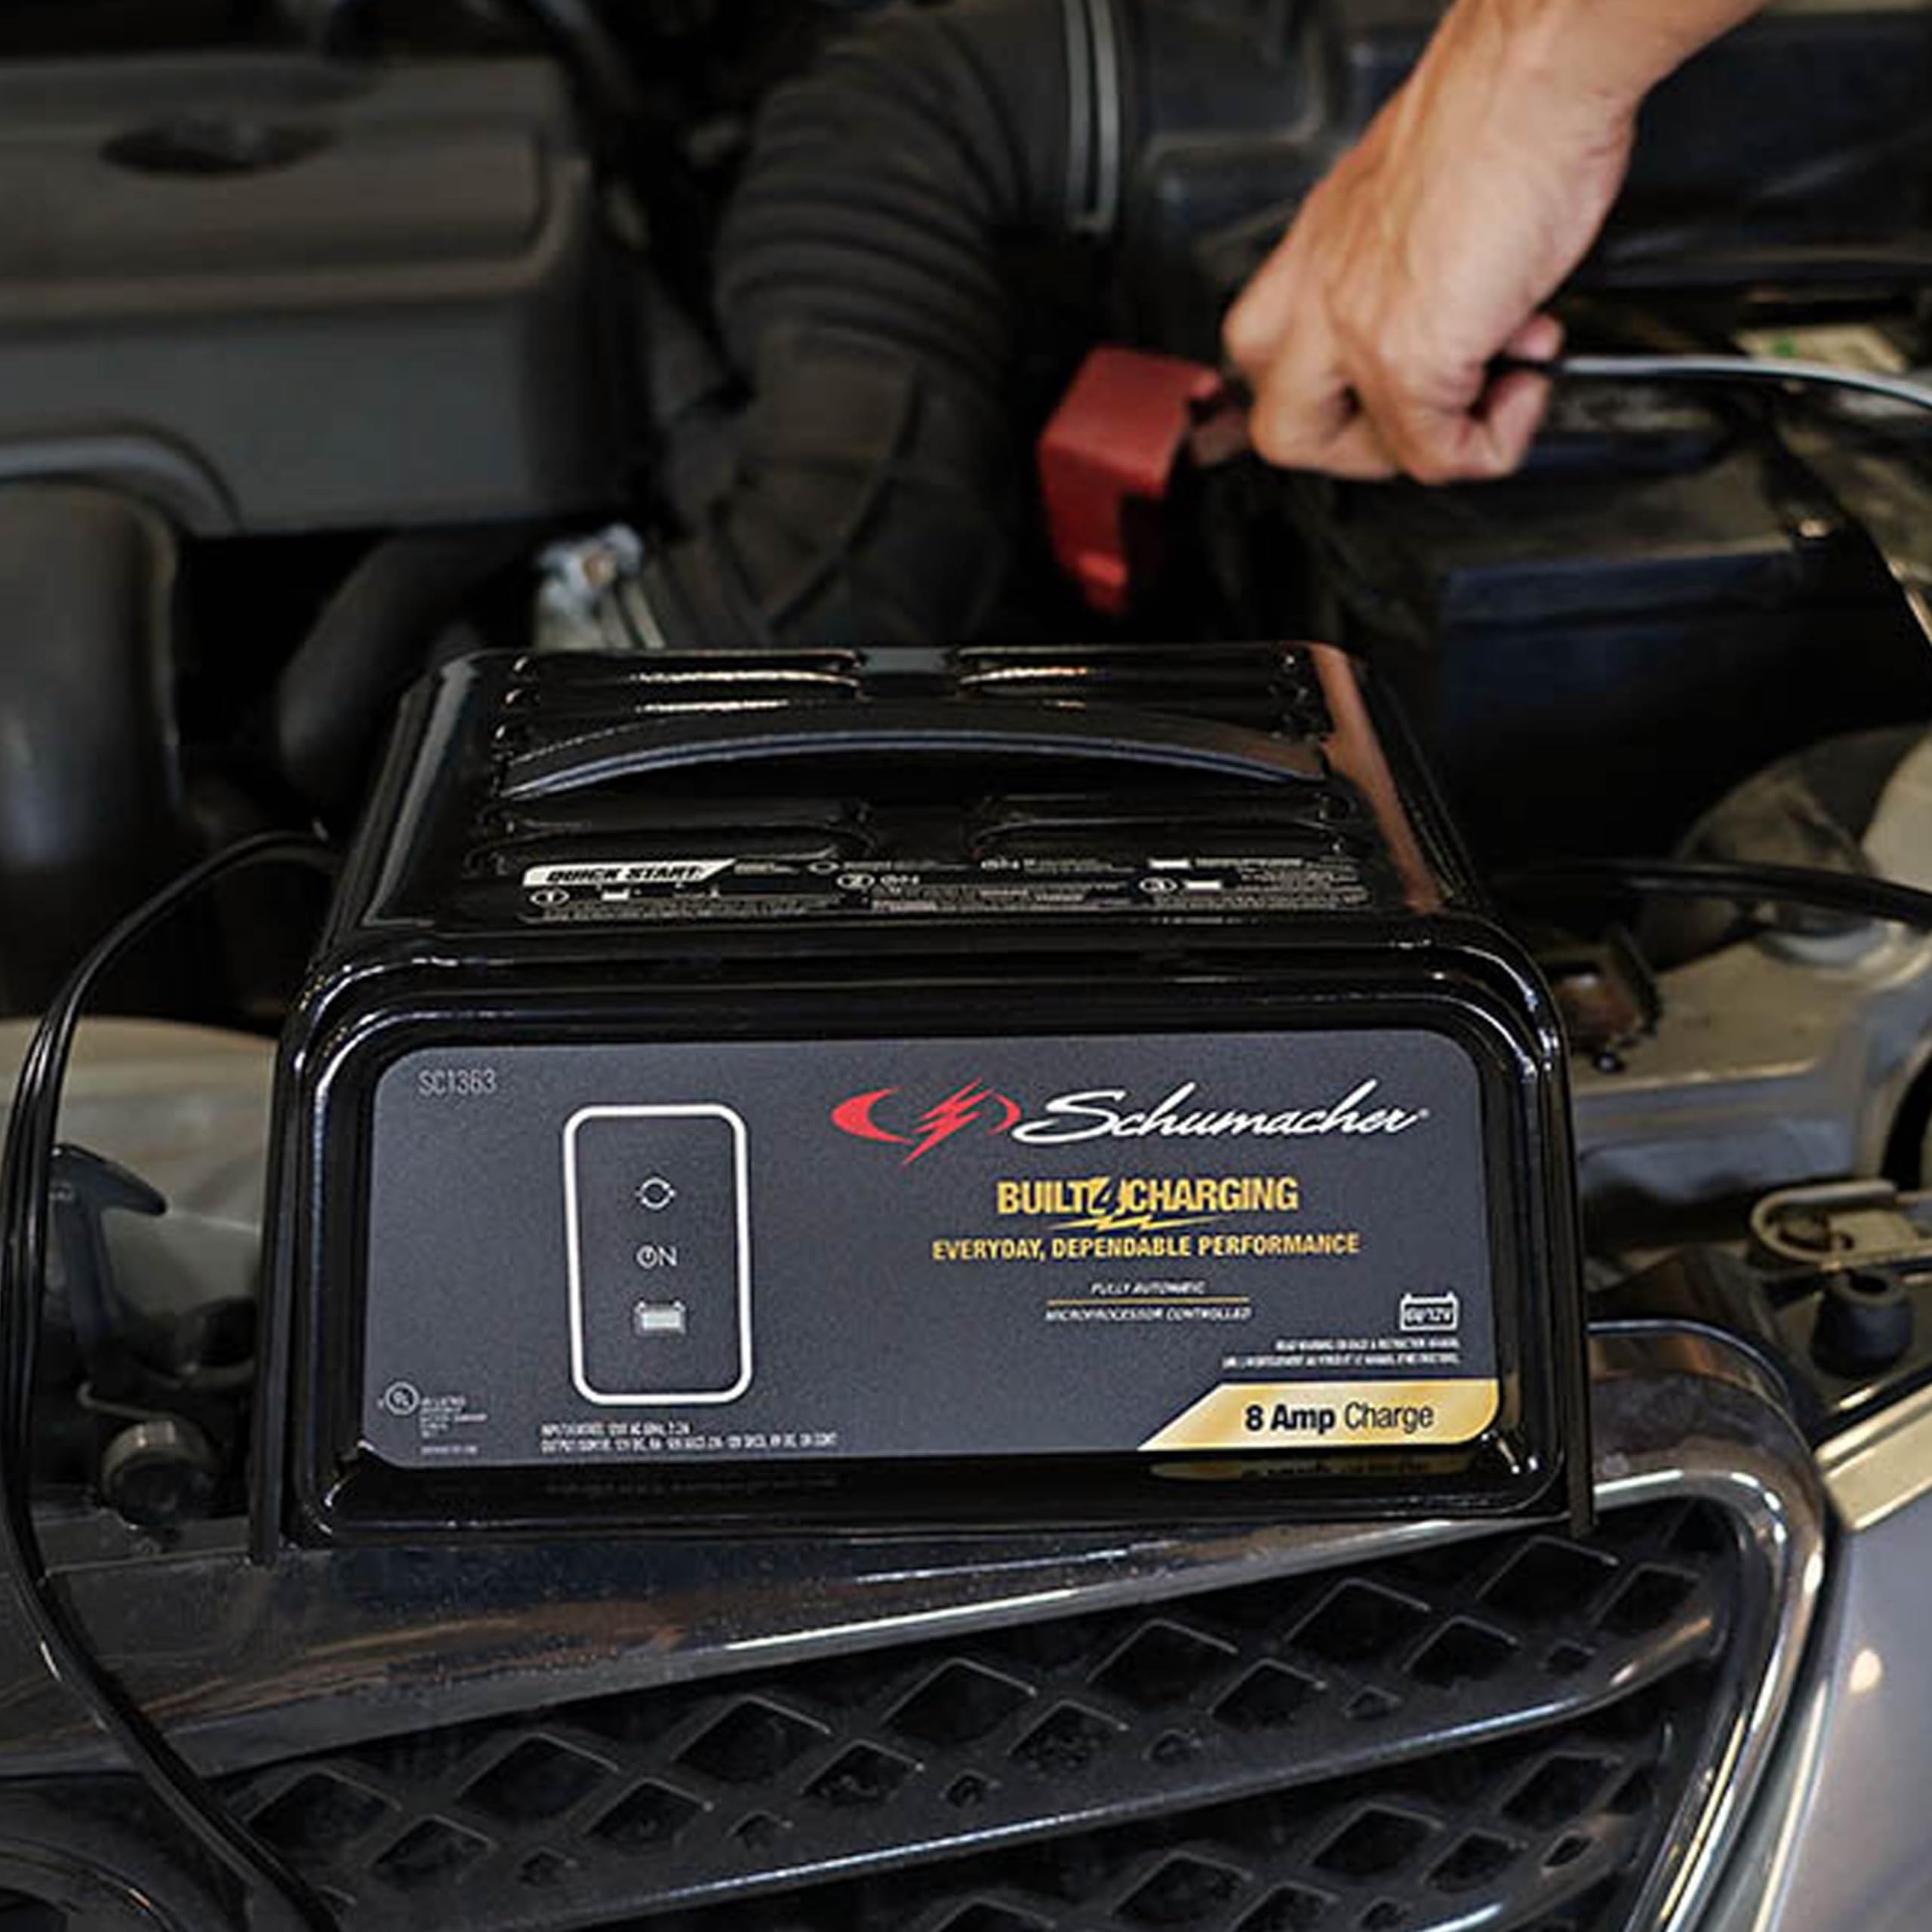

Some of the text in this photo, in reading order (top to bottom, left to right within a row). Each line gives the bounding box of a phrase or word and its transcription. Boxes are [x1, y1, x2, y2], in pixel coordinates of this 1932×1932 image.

[546, 869, 621, 881] QUICK
[1011, 1079, 1419, 1143] Schumacher
[933, 1232, 1360, 1261] EVERYDAY, DEPENDABLE PERFORMANCE
[1245, 1401, 1434, 1434] 8 Amp Charge
